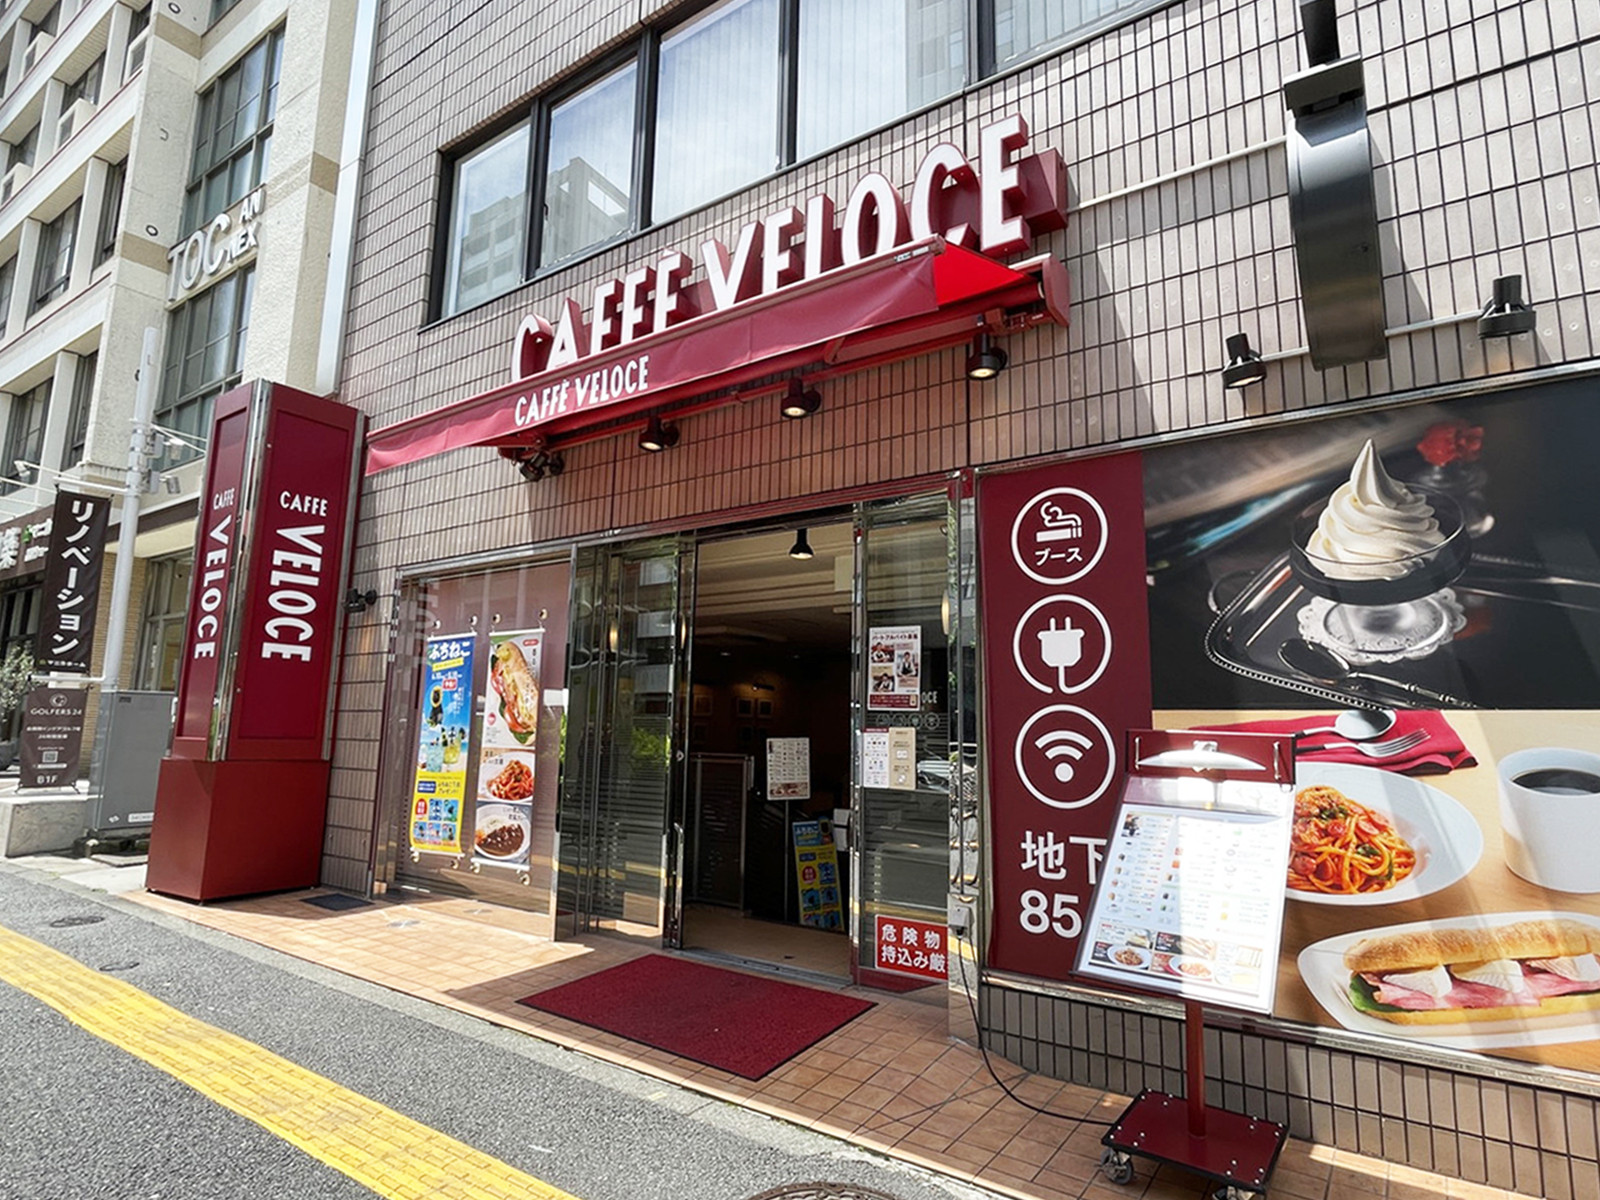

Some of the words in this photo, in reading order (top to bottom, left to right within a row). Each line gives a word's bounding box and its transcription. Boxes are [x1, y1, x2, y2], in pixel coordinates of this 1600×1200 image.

[240, 188, 265, 224] AN
[701, 113, 1031, 311] VELOCE
[166, 213, 231, 303] TOC
[228, 222, 260, 262] NEX
[575, 355, 649, 407] VELOCE
[280, 491, 328, 517] CAFFE
[1035, 547, 1083, 566] ブース
[52, 500, 95, 655] リノベーション
[194, 514, 231, 659] VELOCE
[261, 525, 326, 662] VELOCE
[429, 641, 471, 660] ふちねこ
[36, 775, 58, 785] B1F
[1019, 889, 1083, 939] 85
[881, 924, 941, 950] 危険物
[881, 944, 946, 973] 持込み厳
